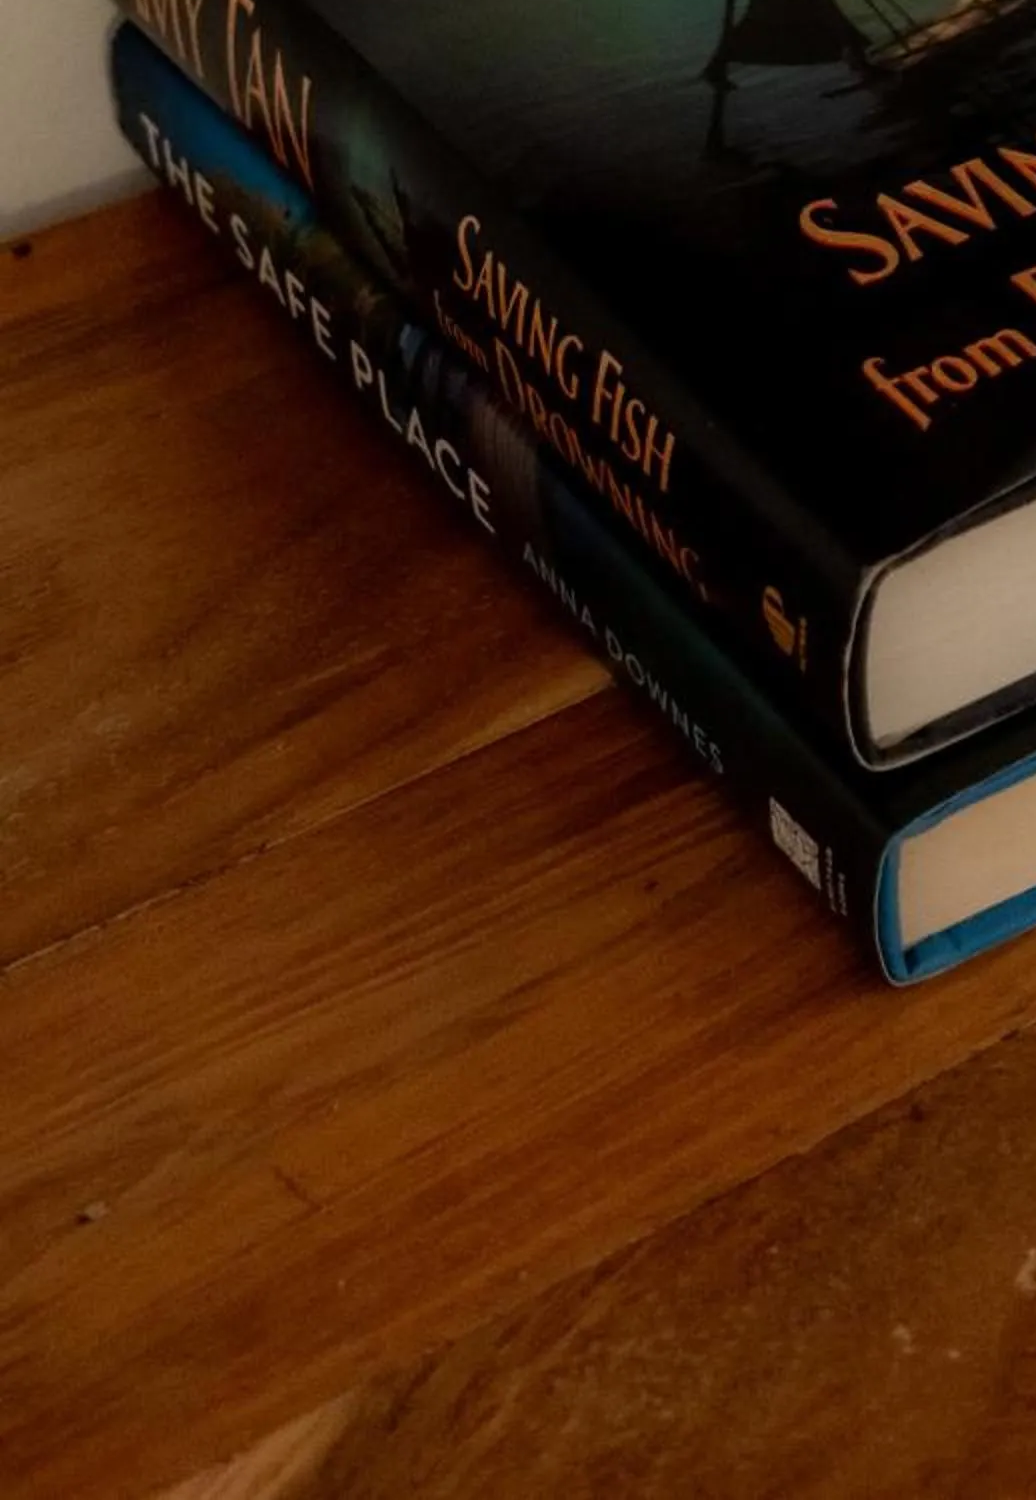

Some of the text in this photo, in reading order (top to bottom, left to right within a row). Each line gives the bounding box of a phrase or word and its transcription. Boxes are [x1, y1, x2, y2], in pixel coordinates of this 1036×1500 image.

[138, 111, 497, 535] THE SAFE PLACE
[452, 213, 677, 495] SAVING FISH
[493, 336, 711, 604] DROWNING
[522, 540, 725, 775] ANNA DOWNES
